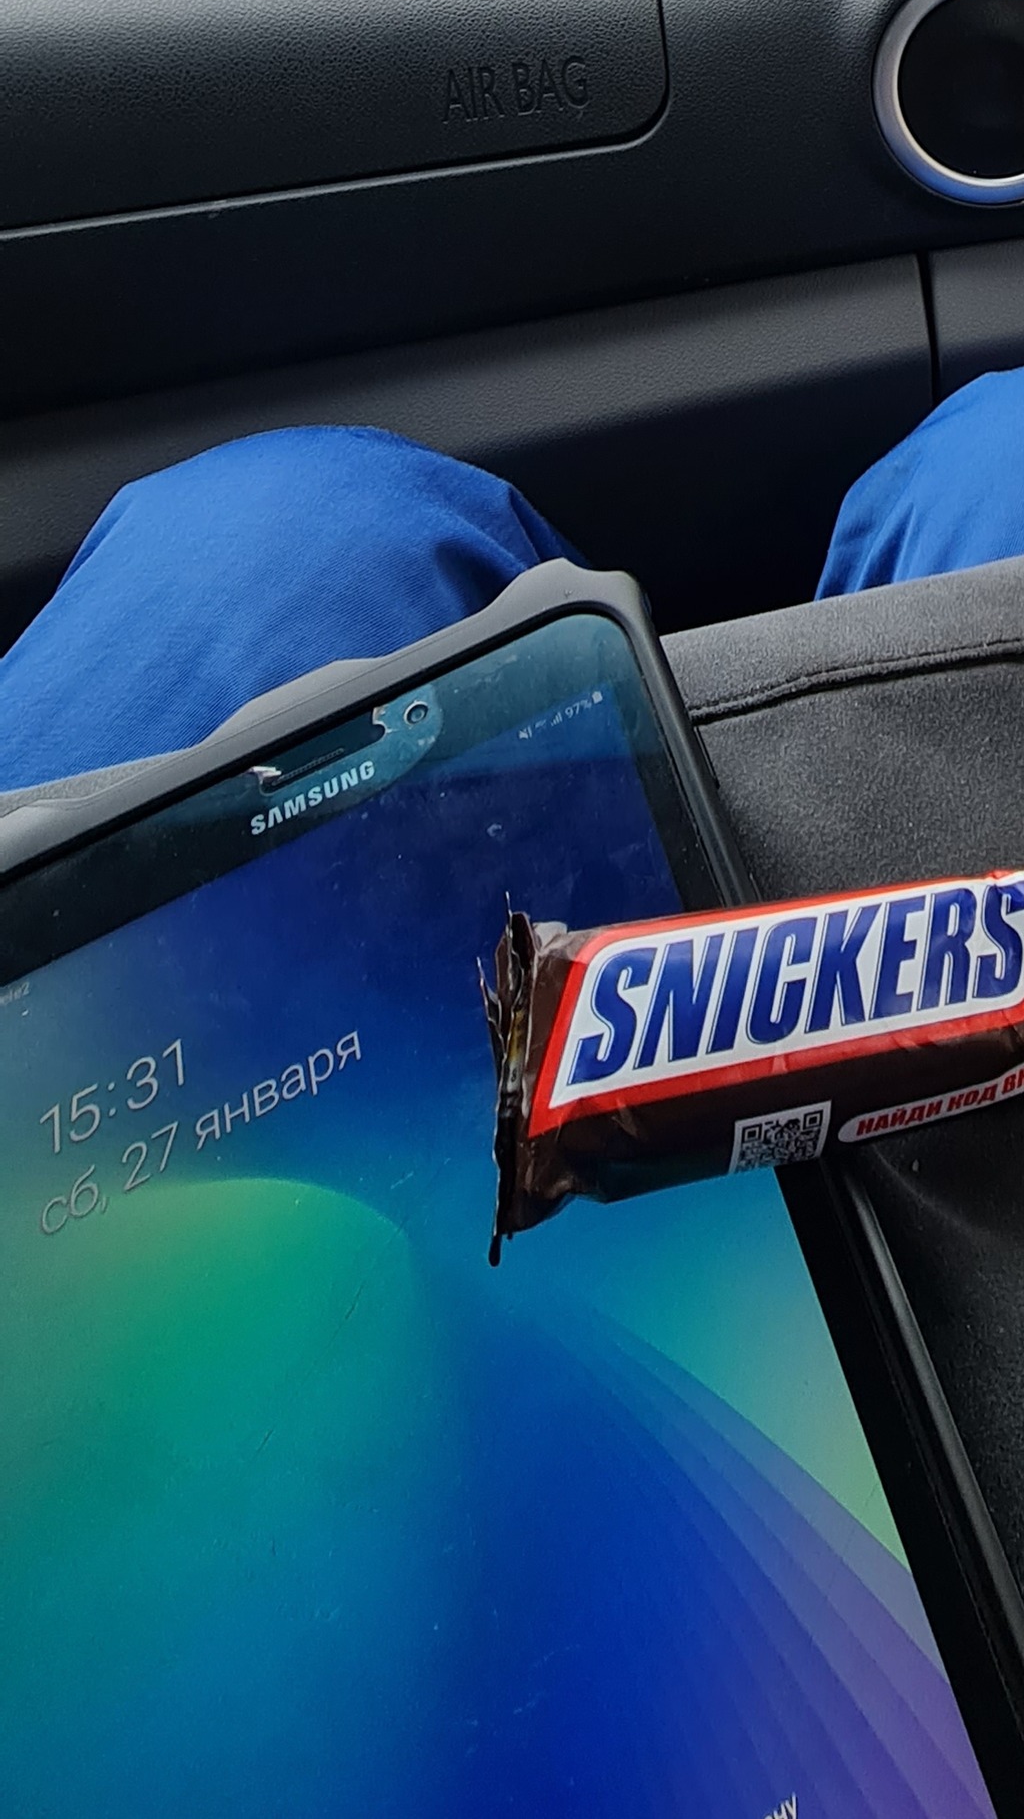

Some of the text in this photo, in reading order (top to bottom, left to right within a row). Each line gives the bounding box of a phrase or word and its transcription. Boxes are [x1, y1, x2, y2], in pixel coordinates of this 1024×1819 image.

[443, 55, 590, 123] AIR BAG
[564, 699, 592, 719] 97%
[250, 761, 375, 835] SAMSUNG
[39, 1038, 187, 1154] 15:31
[855, 1099, 941, 1136] НАЙДИ
[946, 1082, 998, 1113] КОД
[39, 1030, 363, 1237] сб, 27 января
